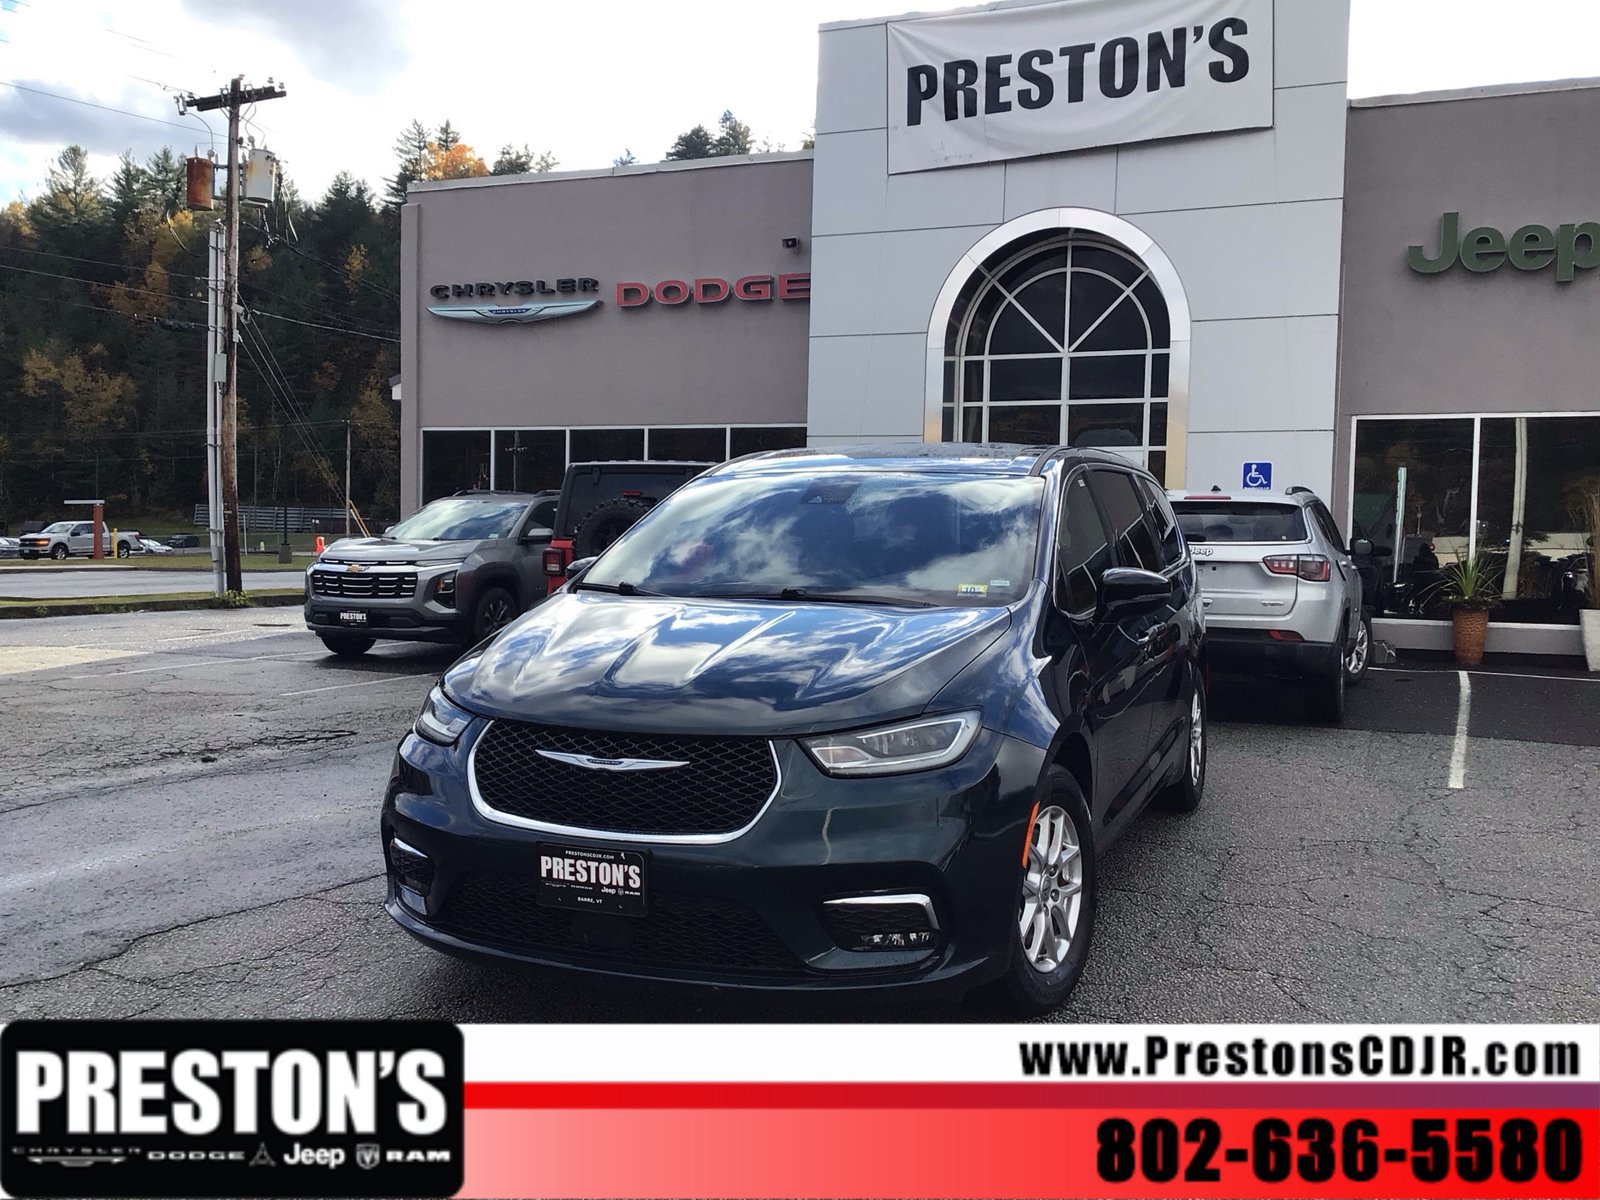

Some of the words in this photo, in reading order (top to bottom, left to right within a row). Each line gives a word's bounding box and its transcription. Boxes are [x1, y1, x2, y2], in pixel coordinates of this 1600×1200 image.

[907, 17, 1250, 127] PRESTON'S
[1407, 212, 1600, 282] Jeep
[430, 277, 599, 299] CHRYSLER
[616, 272, 811, 308] DODGE
[1190, 547, 1214, 557] Jeep
[540, 856, 641, 889] PRESTON'S
[601, 886, 617, 895] Jeep
